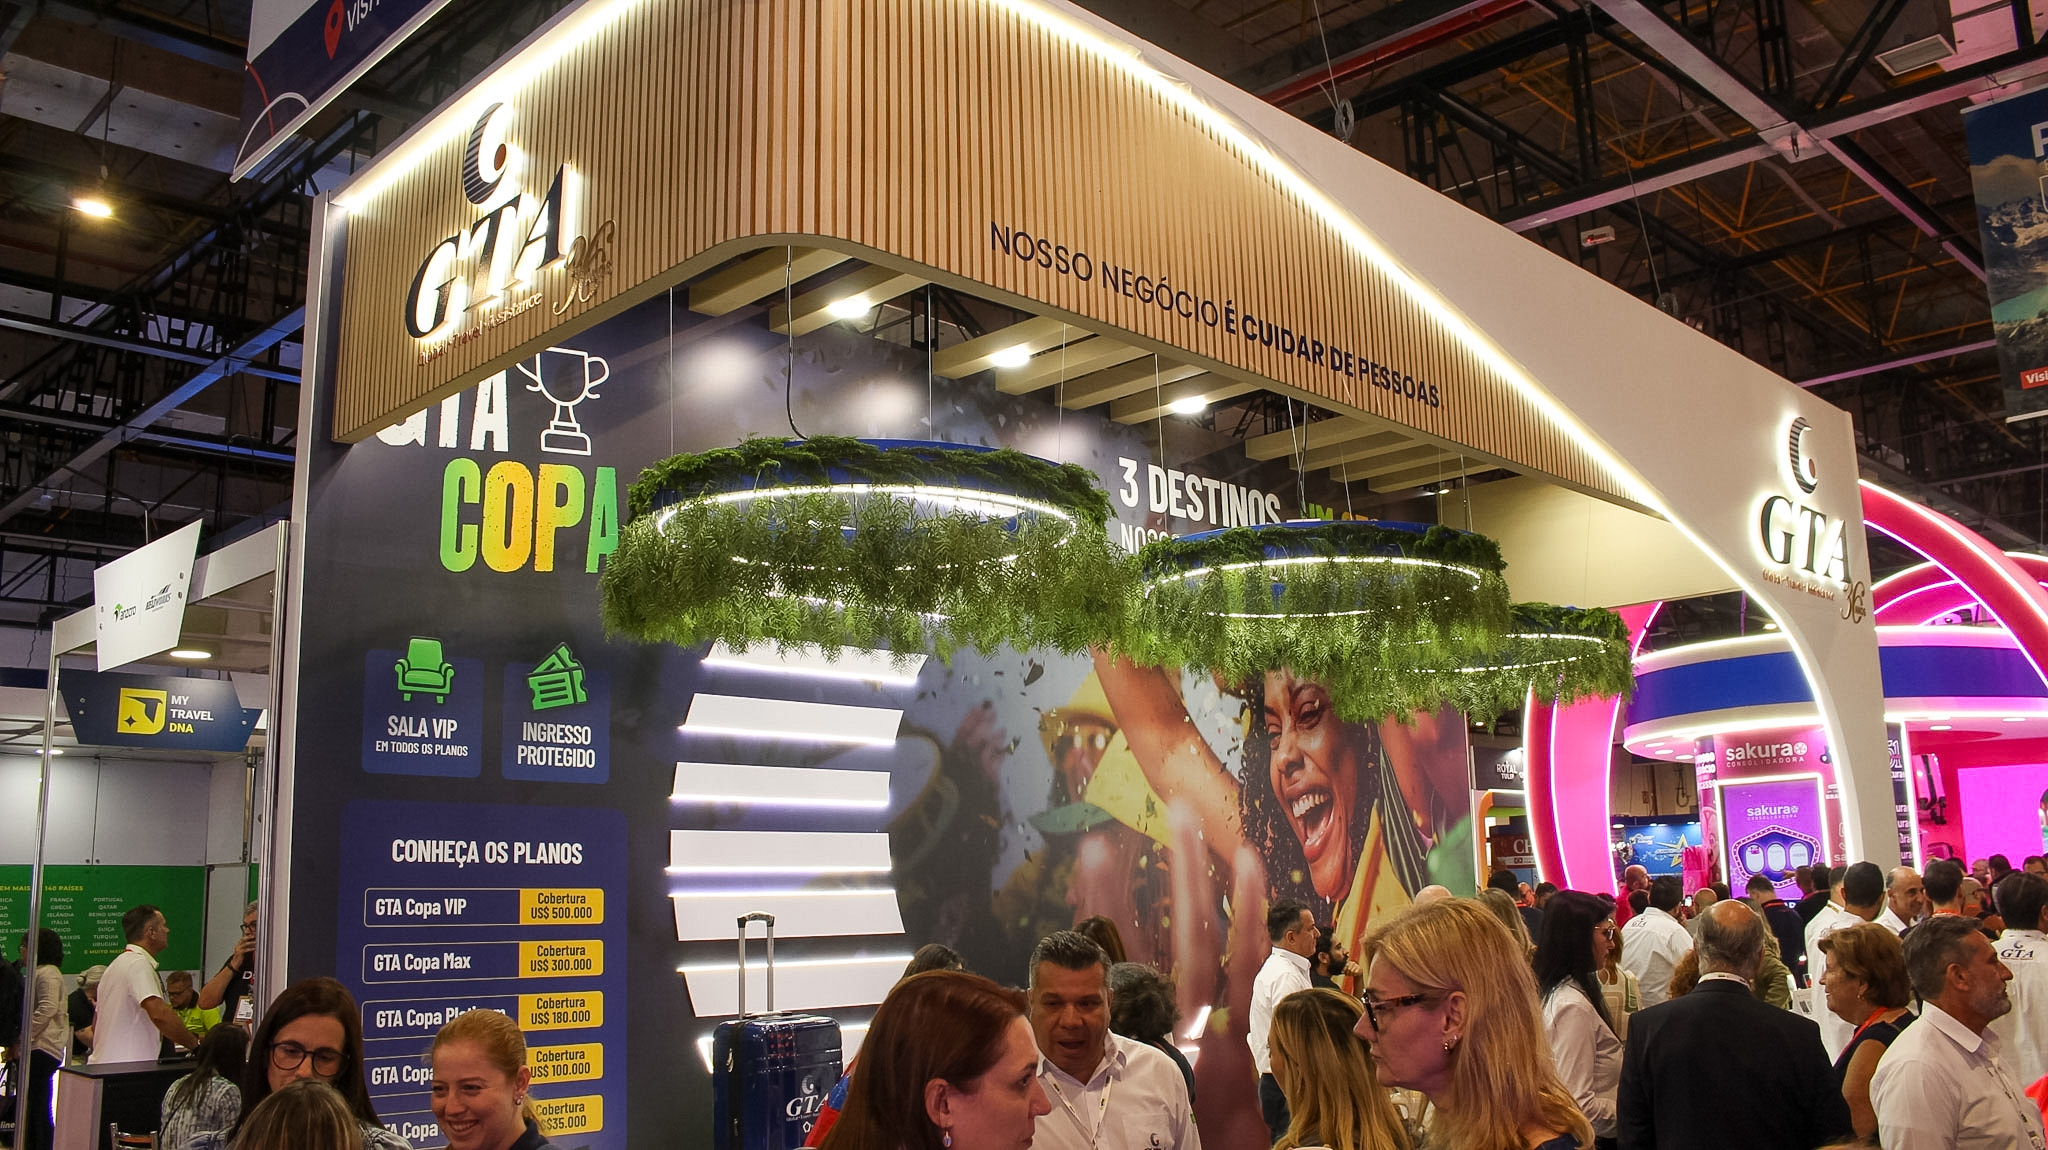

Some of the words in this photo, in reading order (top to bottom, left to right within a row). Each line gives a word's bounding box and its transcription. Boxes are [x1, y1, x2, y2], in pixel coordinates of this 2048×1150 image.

[405, 162, 568, 339] GTA
[991, 221, 1093, 281] NOSSO
[1101, 260, 1218, 328] NEGÓCIO
[1224, 300, 1236, 335] É
[1241, 314, 1325, 367] CUIDAR
[1329, 345, 1354, 378] DE
[1118, 456, 1139, 508] 3
[1148, 463, 1281, 528] DESTINOS
[439, 457, 620, 573] COPA
[1760, 495, 1851, 584] GTA
[171, 695, 190, 705] MY
[170, 709, 214, 721] TRAVEL
[169, 722, 194, 734] DNA
[388, 715, 428, 738] SALA
[432, 718, 458, 739] VIP
[522, 721, 592, 745] INGRESSO
[375, 740, 388, 752] EM
[391, 741, 420, 754] TODOS
[421, 743, 434, 754] OS
[435, 744, 469, 757] PLANOS
[517, 745, 596, 769] PROTEGIDO
[1725, 742, 1795, 762] sakura
[1726, 755, 1805, 768] CONSOLIDADORA
[1746, 804, 1790, 817] sakura
[391, 838, 480, 868] CONHEÇA
[484, 841, 508, 864] OS
[513, 841, 583, 865] PLANOS
[58, 884, 84, 892] PAÍSES
[537, 892, 586, 905] Cobertura
[375, 898, 402, 916] GTA
[405, 897, 441, 919] Copa
[444, 897, 467, 915] VIP
[530, 907, 549, 920] US$
[551, 906, 592, 919] 500.000
[536, 944, 586, 957] Cobertura
[2000, 948, 2034, 958] GTA
[373, 954, 401, 972] GTA
[404, 953, 440, 974] Copa
[443, 952, 471, 970] Max
[530, 959, 549, 973] US$
[551, 958, 592, 971] 300.000
[536, 996, 586, 1009] Cobertura
[376, 1010, 403, 1028] GTA
[406, 1009, 443, 1030] Copa
[530, 1011, 549, 1025] US$
[551, 1010, 591, 1023] 180.000
[536, 1050, 585, 1062] Cobertura
[371, 1066, 399, 1085] GTA
[530, 1064, 549, 1078] US$
[551, 1062, 591, 1077] 100.000
[536, 1103, 585, 1116] Cobertura
[785, 1092, 829, 1117] GTA
[402, 1121, 439, 1142] Copa
